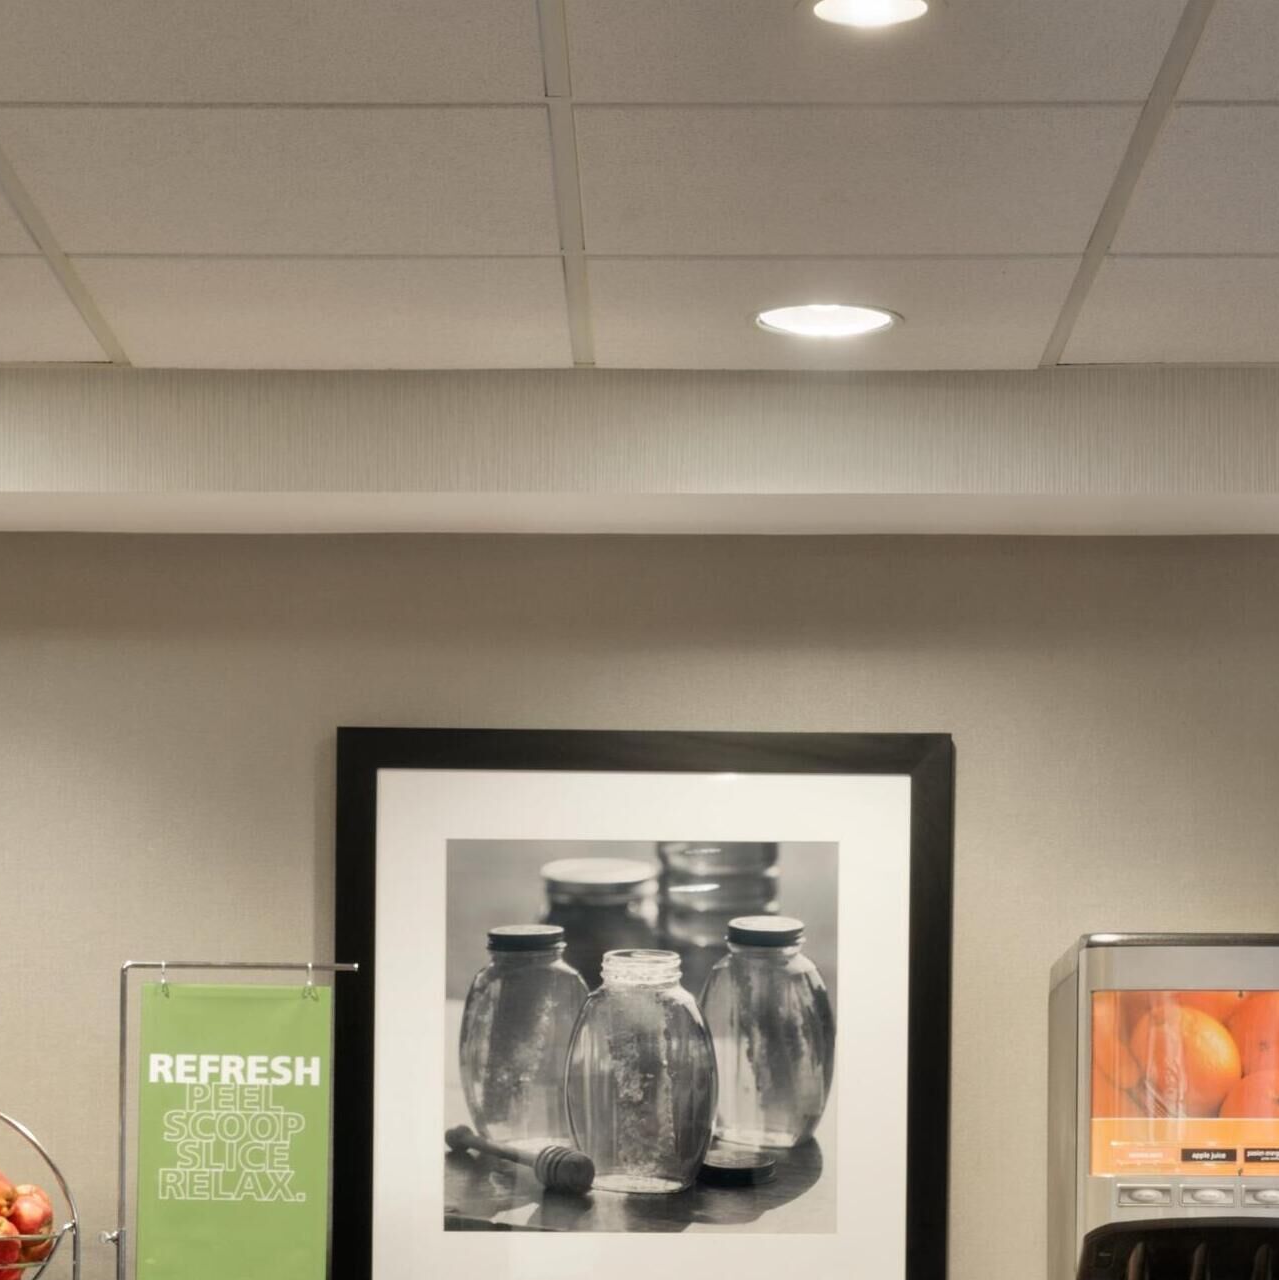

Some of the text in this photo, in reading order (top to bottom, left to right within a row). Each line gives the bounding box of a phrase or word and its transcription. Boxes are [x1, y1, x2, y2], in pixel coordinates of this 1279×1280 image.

[149, 1053, 320, 1086] REFRESH
[186, 1083, 283, 1112] PEEL
[163, 1111, 306, 1142] SCOOP
[176, 1140, 290, 1172] SLICE
[1192, 1151, 1226, 1161] apple juice
[159, 1168, 306, 1202] RELAX.
